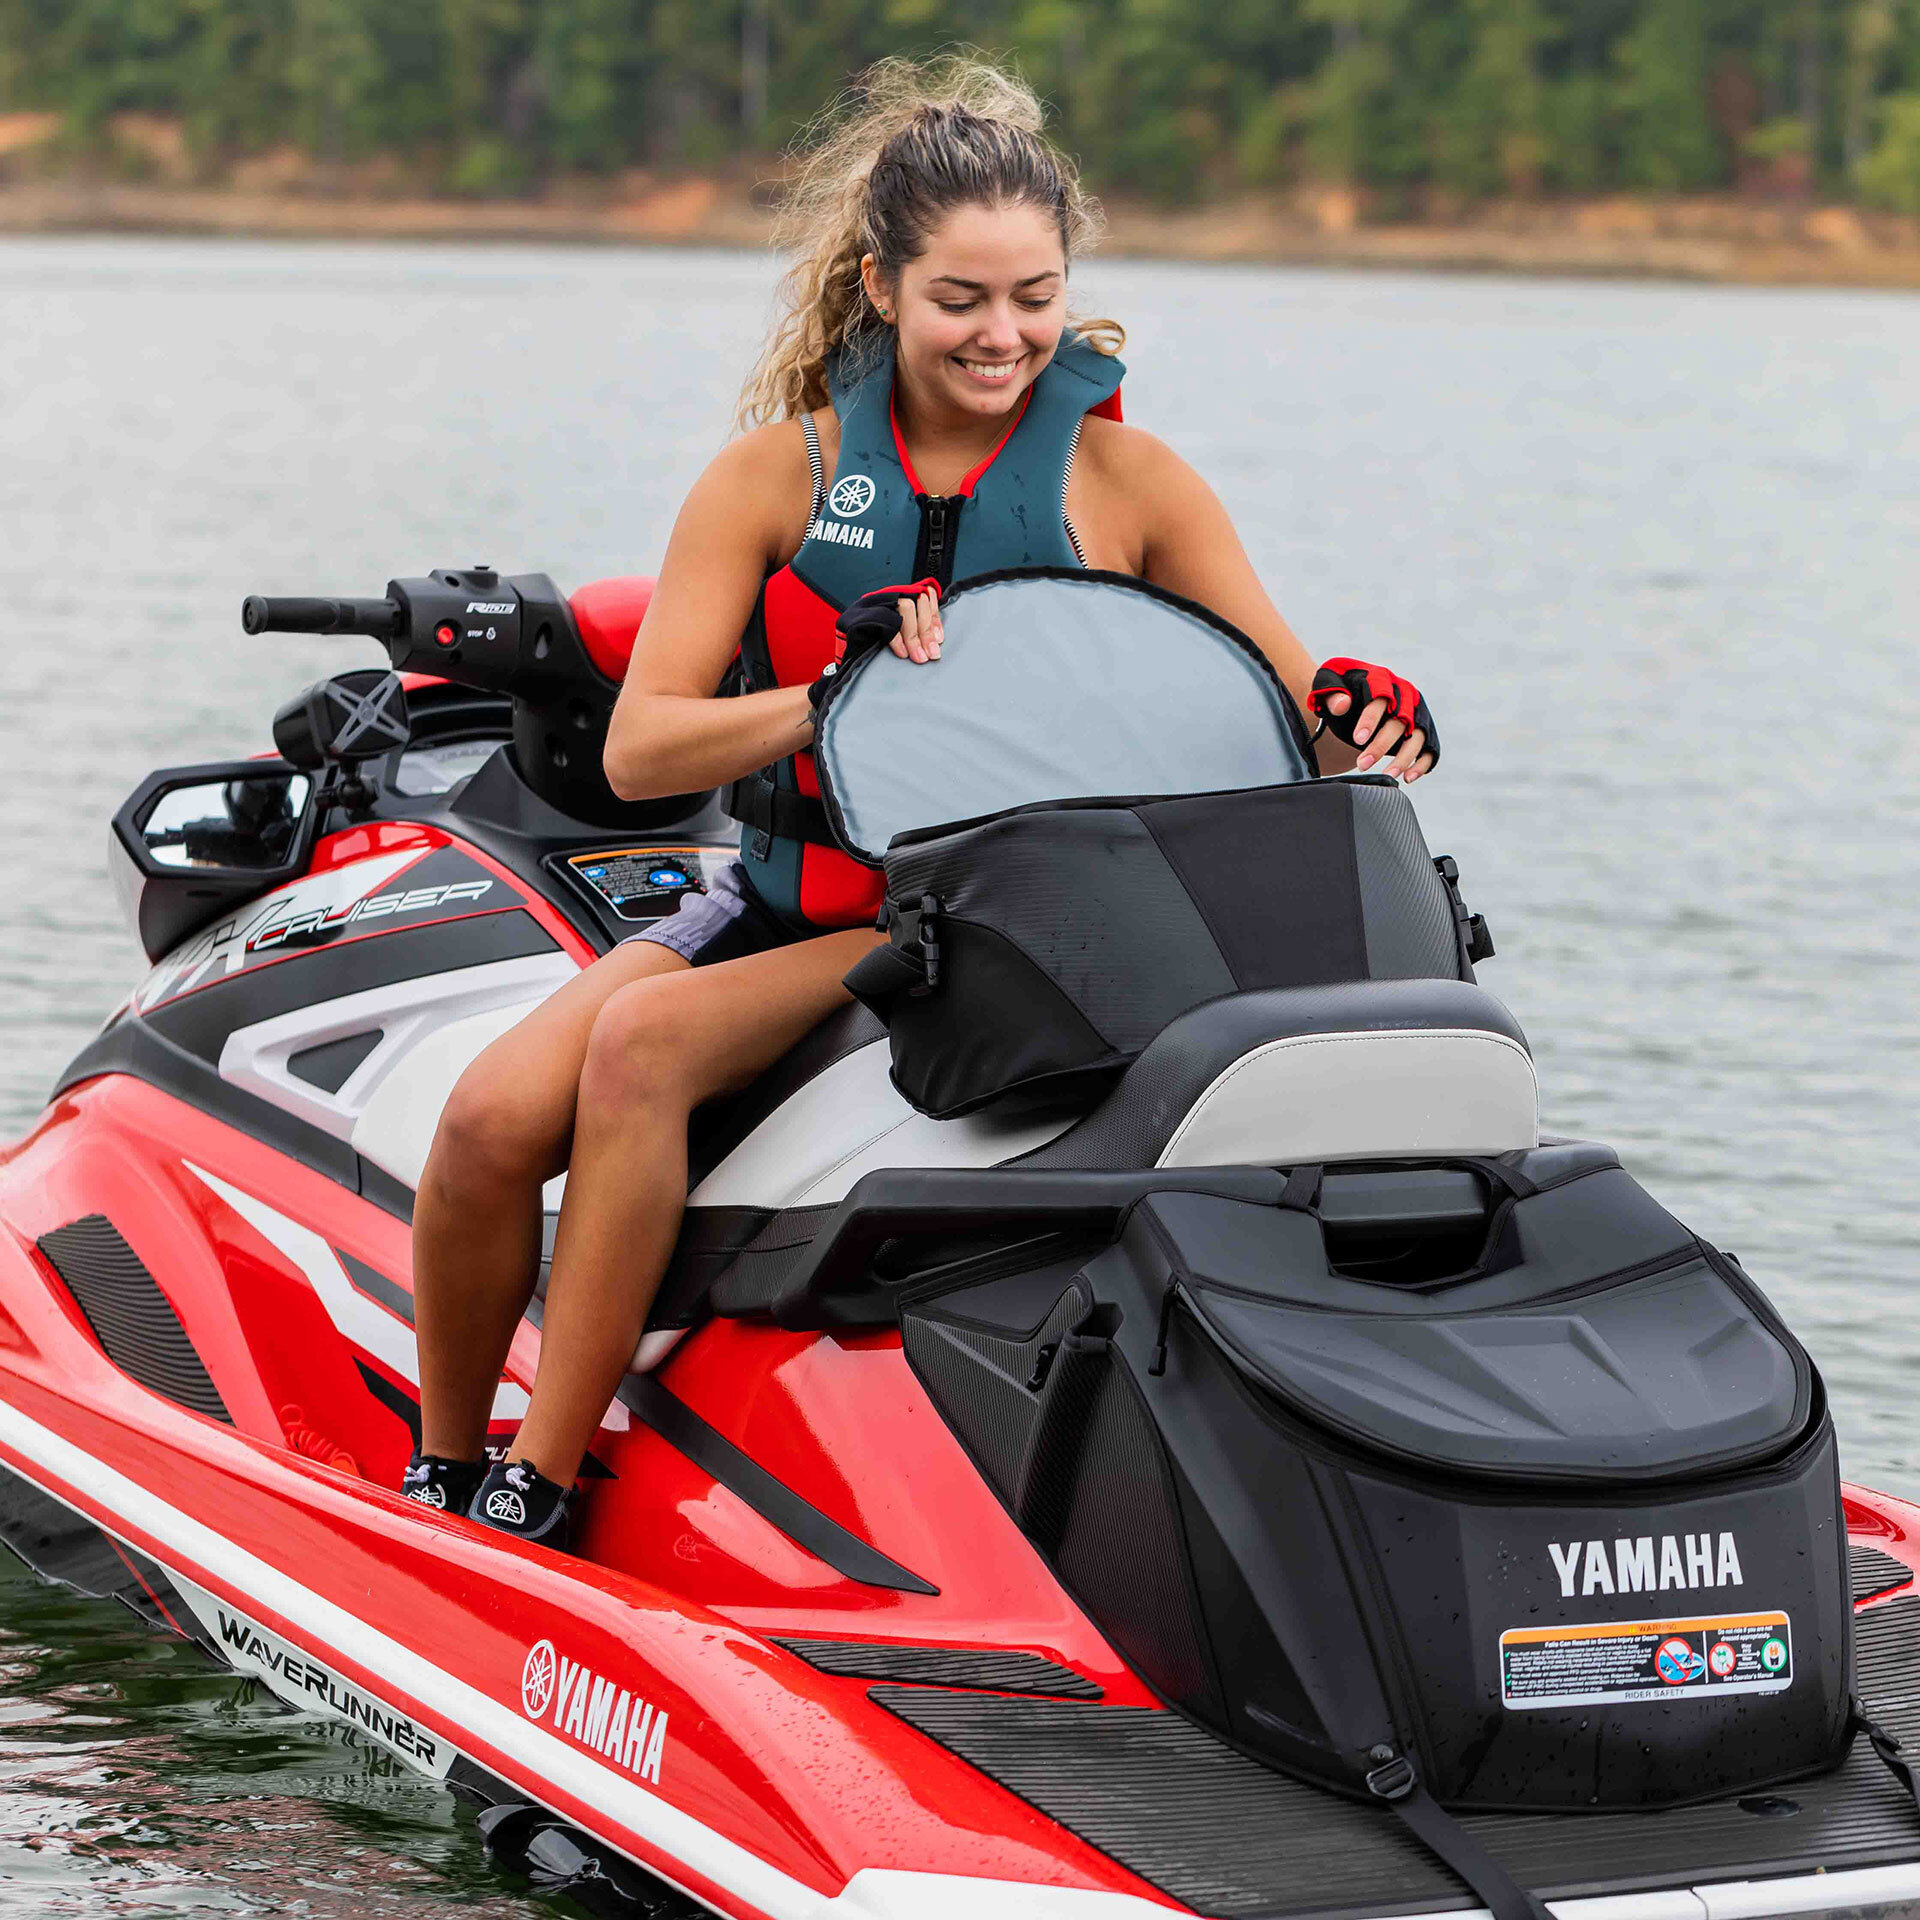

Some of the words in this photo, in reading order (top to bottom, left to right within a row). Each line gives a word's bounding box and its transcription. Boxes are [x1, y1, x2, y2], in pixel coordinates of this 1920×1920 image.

[810, 519, 875, 549] AMAHA
[253, 880, 493, 950] CRUISER
[1548, 1532, 1743, 1597] YAMAHA
[218, 1609, 436, 1767] WAVERUNNER
[552, 1656, 668, 1785] YAMAHA
[1625, 1690, 1651, 1699] RIDER
[1654, 1688, 1684, 1698] SAFETY
